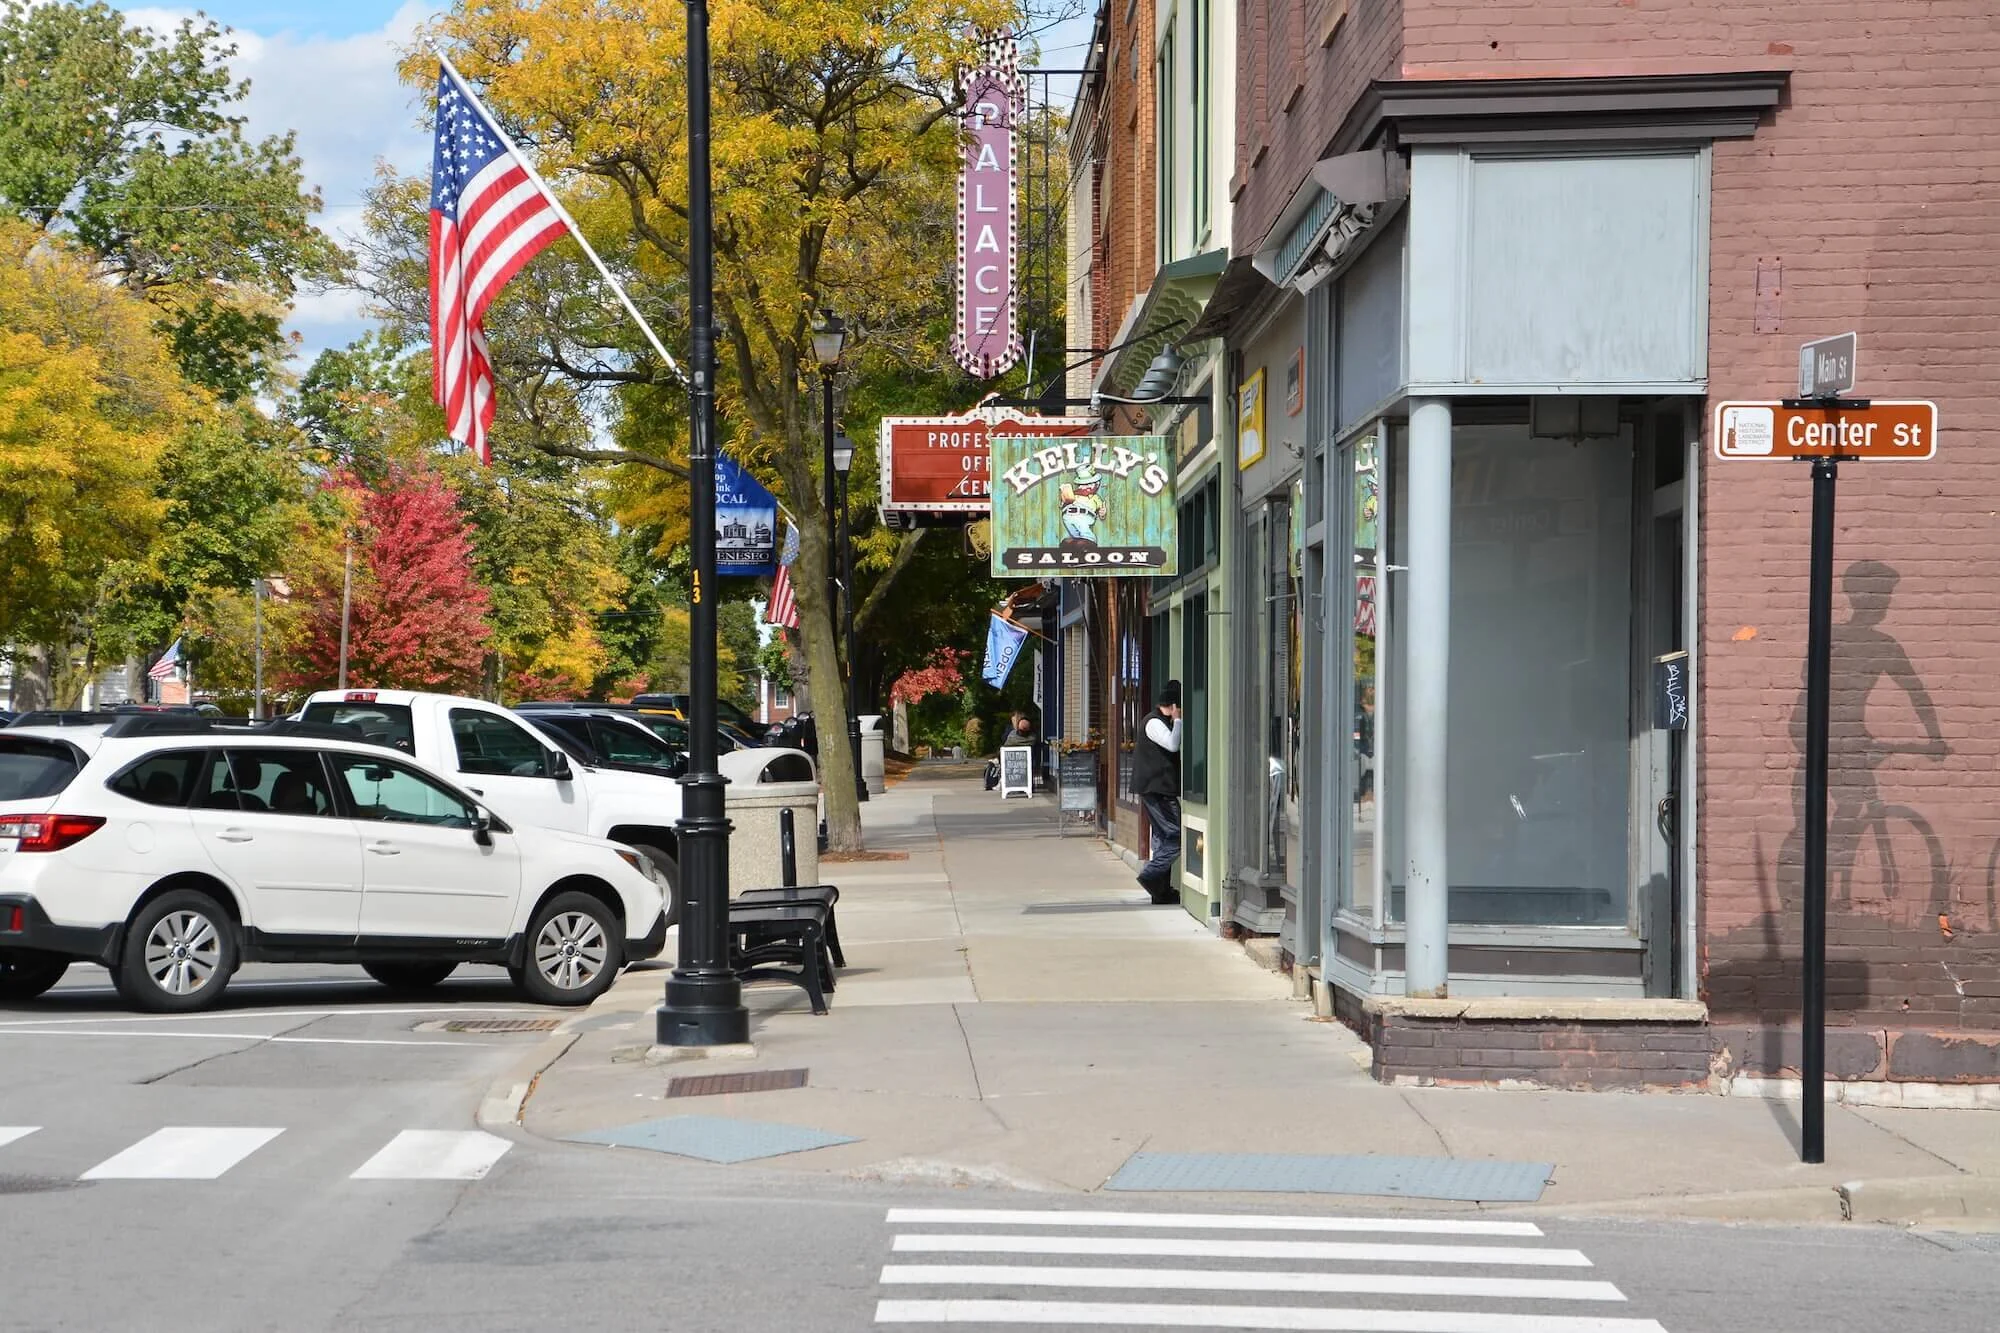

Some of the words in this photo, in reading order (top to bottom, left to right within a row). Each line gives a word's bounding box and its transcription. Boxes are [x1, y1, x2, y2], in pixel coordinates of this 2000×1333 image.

[975, 103, 1000, 335] PALACE
[1818, 352, 1836, 385] Main
[1838, 356, 1847, 380] St
[1787, 415, 1878, 447] Center
[1893, 422, 1921, 447] St
[962, 456, 990, 471] OFF
[1002, 443, 1169, 495] KELLY'S
[716, 484, 731, 492] ink
[960, 480, 990, 496] CEN
[716, 552, 769, 560] ENESEO
[1017, 552, 1149, 564] SALOON
